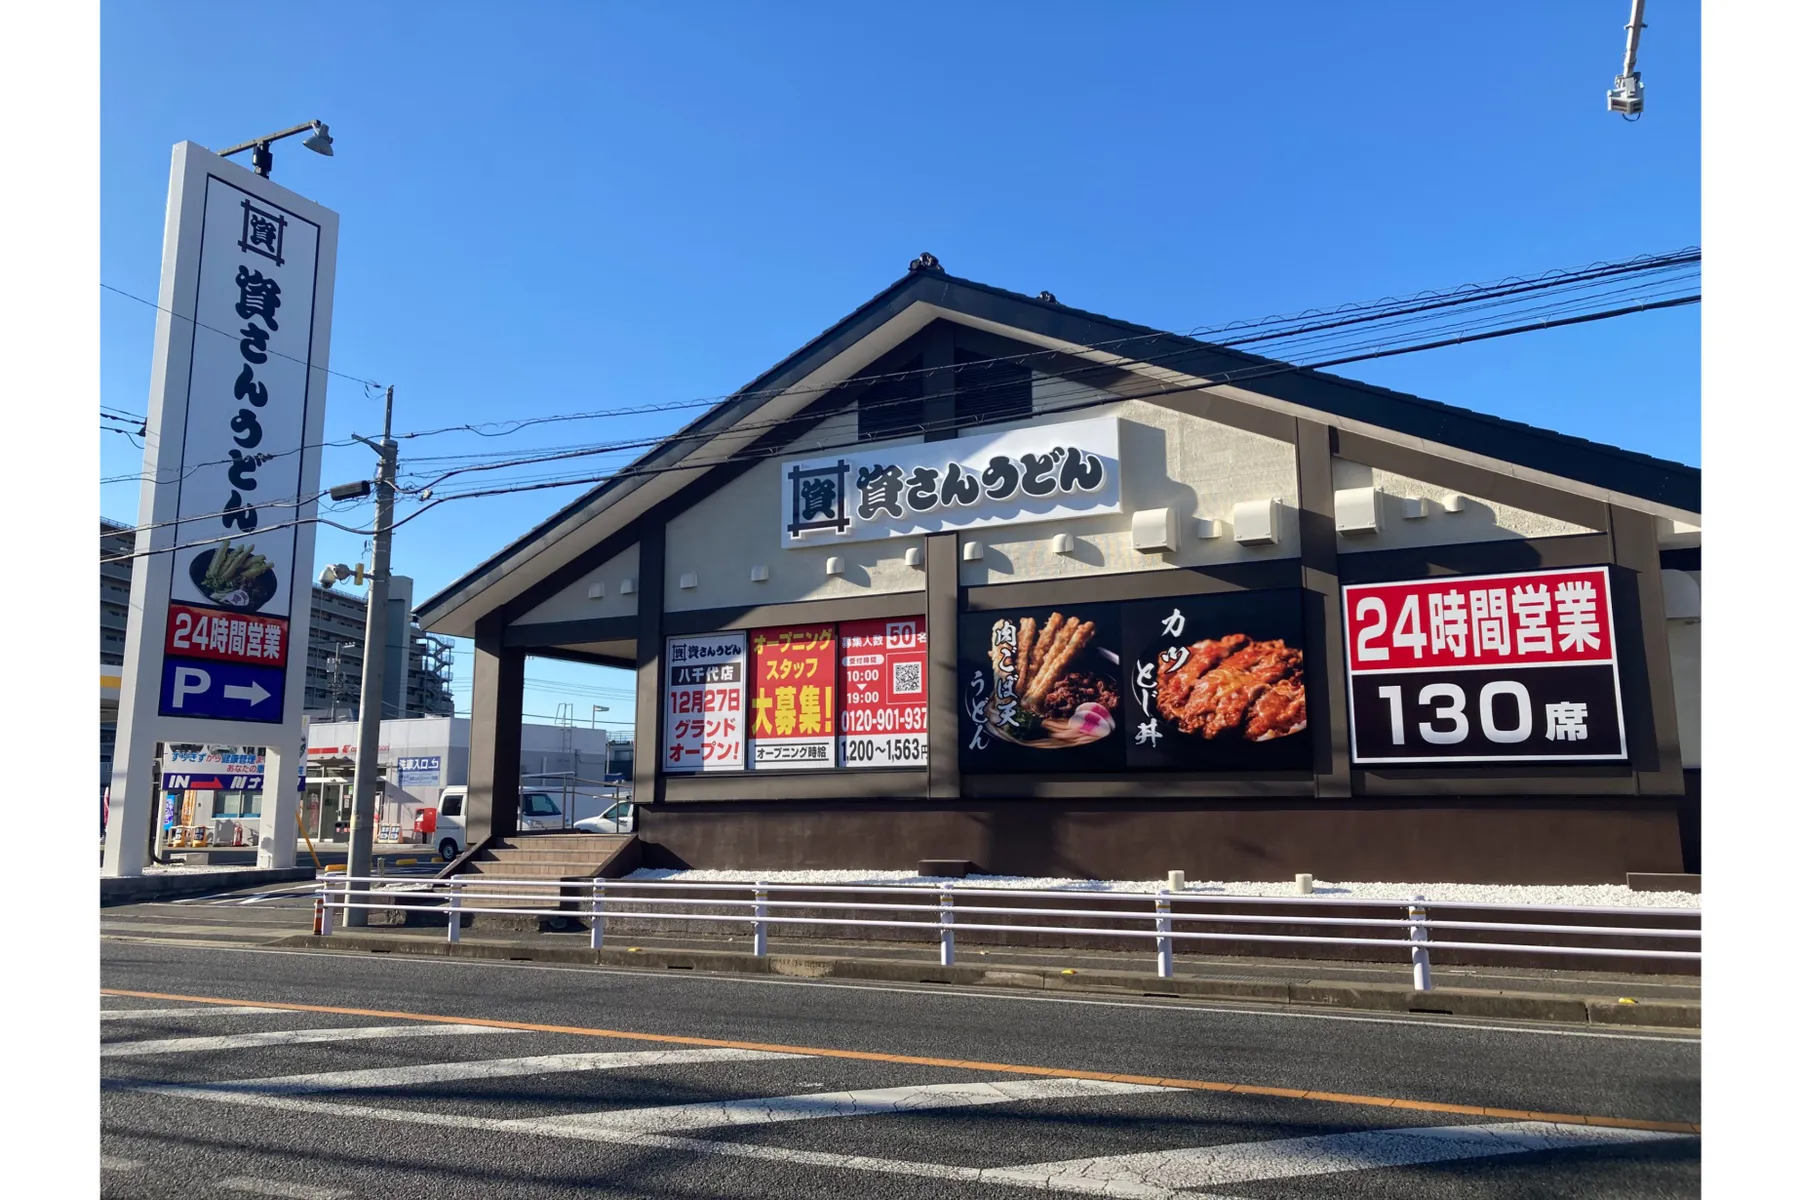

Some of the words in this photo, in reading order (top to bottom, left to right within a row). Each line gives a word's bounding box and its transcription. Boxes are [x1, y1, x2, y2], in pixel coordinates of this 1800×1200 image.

[222, 265, 281, 533] 資さんうどん
[857, 446, 1104, 521] 資さんうどん
[1355, 580, 1601, 662] 24時間営業
[173, 612, 282, 660] 24時間営業
[753, 629, 833, 655] オープニング
[842, 634, 884, 649] 募集人数
[890, 624, 913, 646] 50
[917, 631, 927, 644] 名
[1161, 608, 1191, 673] カツ
[688, 644, 742, 659] 資さんうどん
[849, 656, 877, 665] 受付時間
[678, 665, 734, 683] 八千代店
[766, 658, 818, 681] スタッフ
[847, 669, 879, 682] 10:00
[994, 620, 1020, 728] 肉ごぼ天
[172, 666, 212, 708] P
[847, 691, 879, 704] 19:00
[670, 688, 740, 715] 12月27日
[752, 685, 832, 736] 大募集!
[968, 670, 990, 750] うどん
[1378, 680, 1533, 745] 130
[1545, 701, 1588, 741] 席
[675, 717, 736, 740] グランド
[842, 707, 927, 732] 0120-901-937
[669, 742, 740, 763] オープン!
[756, 745, 827, 760] オープニング時給
[168, 775, 191, 789] IN
